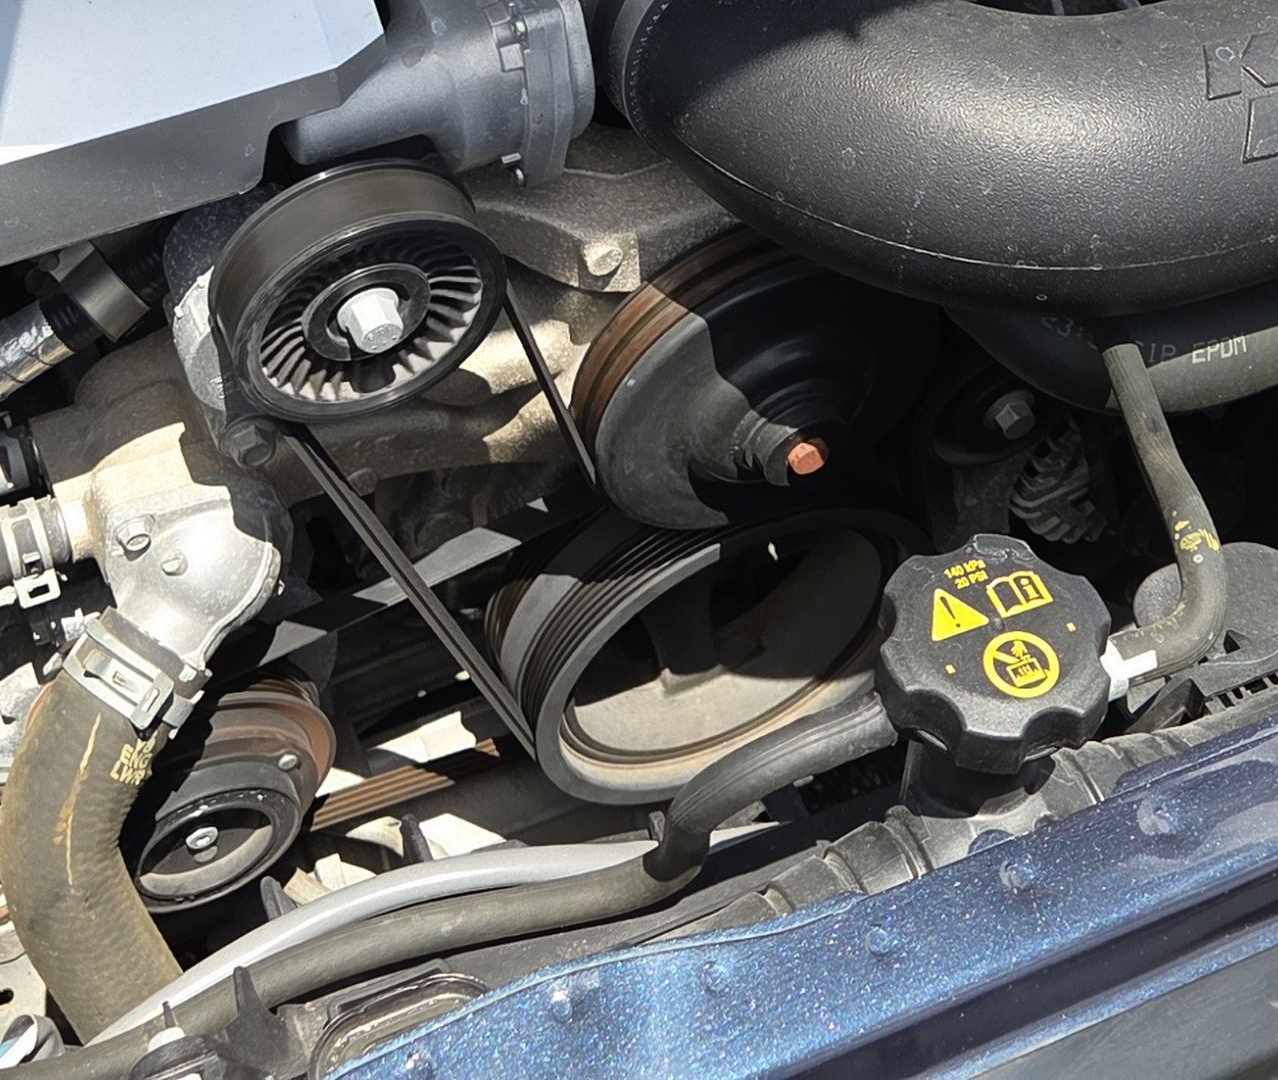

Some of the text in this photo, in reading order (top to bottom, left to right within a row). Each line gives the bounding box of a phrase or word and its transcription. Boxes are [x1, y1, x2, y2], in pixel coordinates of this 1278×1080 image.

[1192, 333, 1247, 364] EPDM
[955, 569, 989, 590] 20 PSI
[120, 743, 153, 769] ENG
